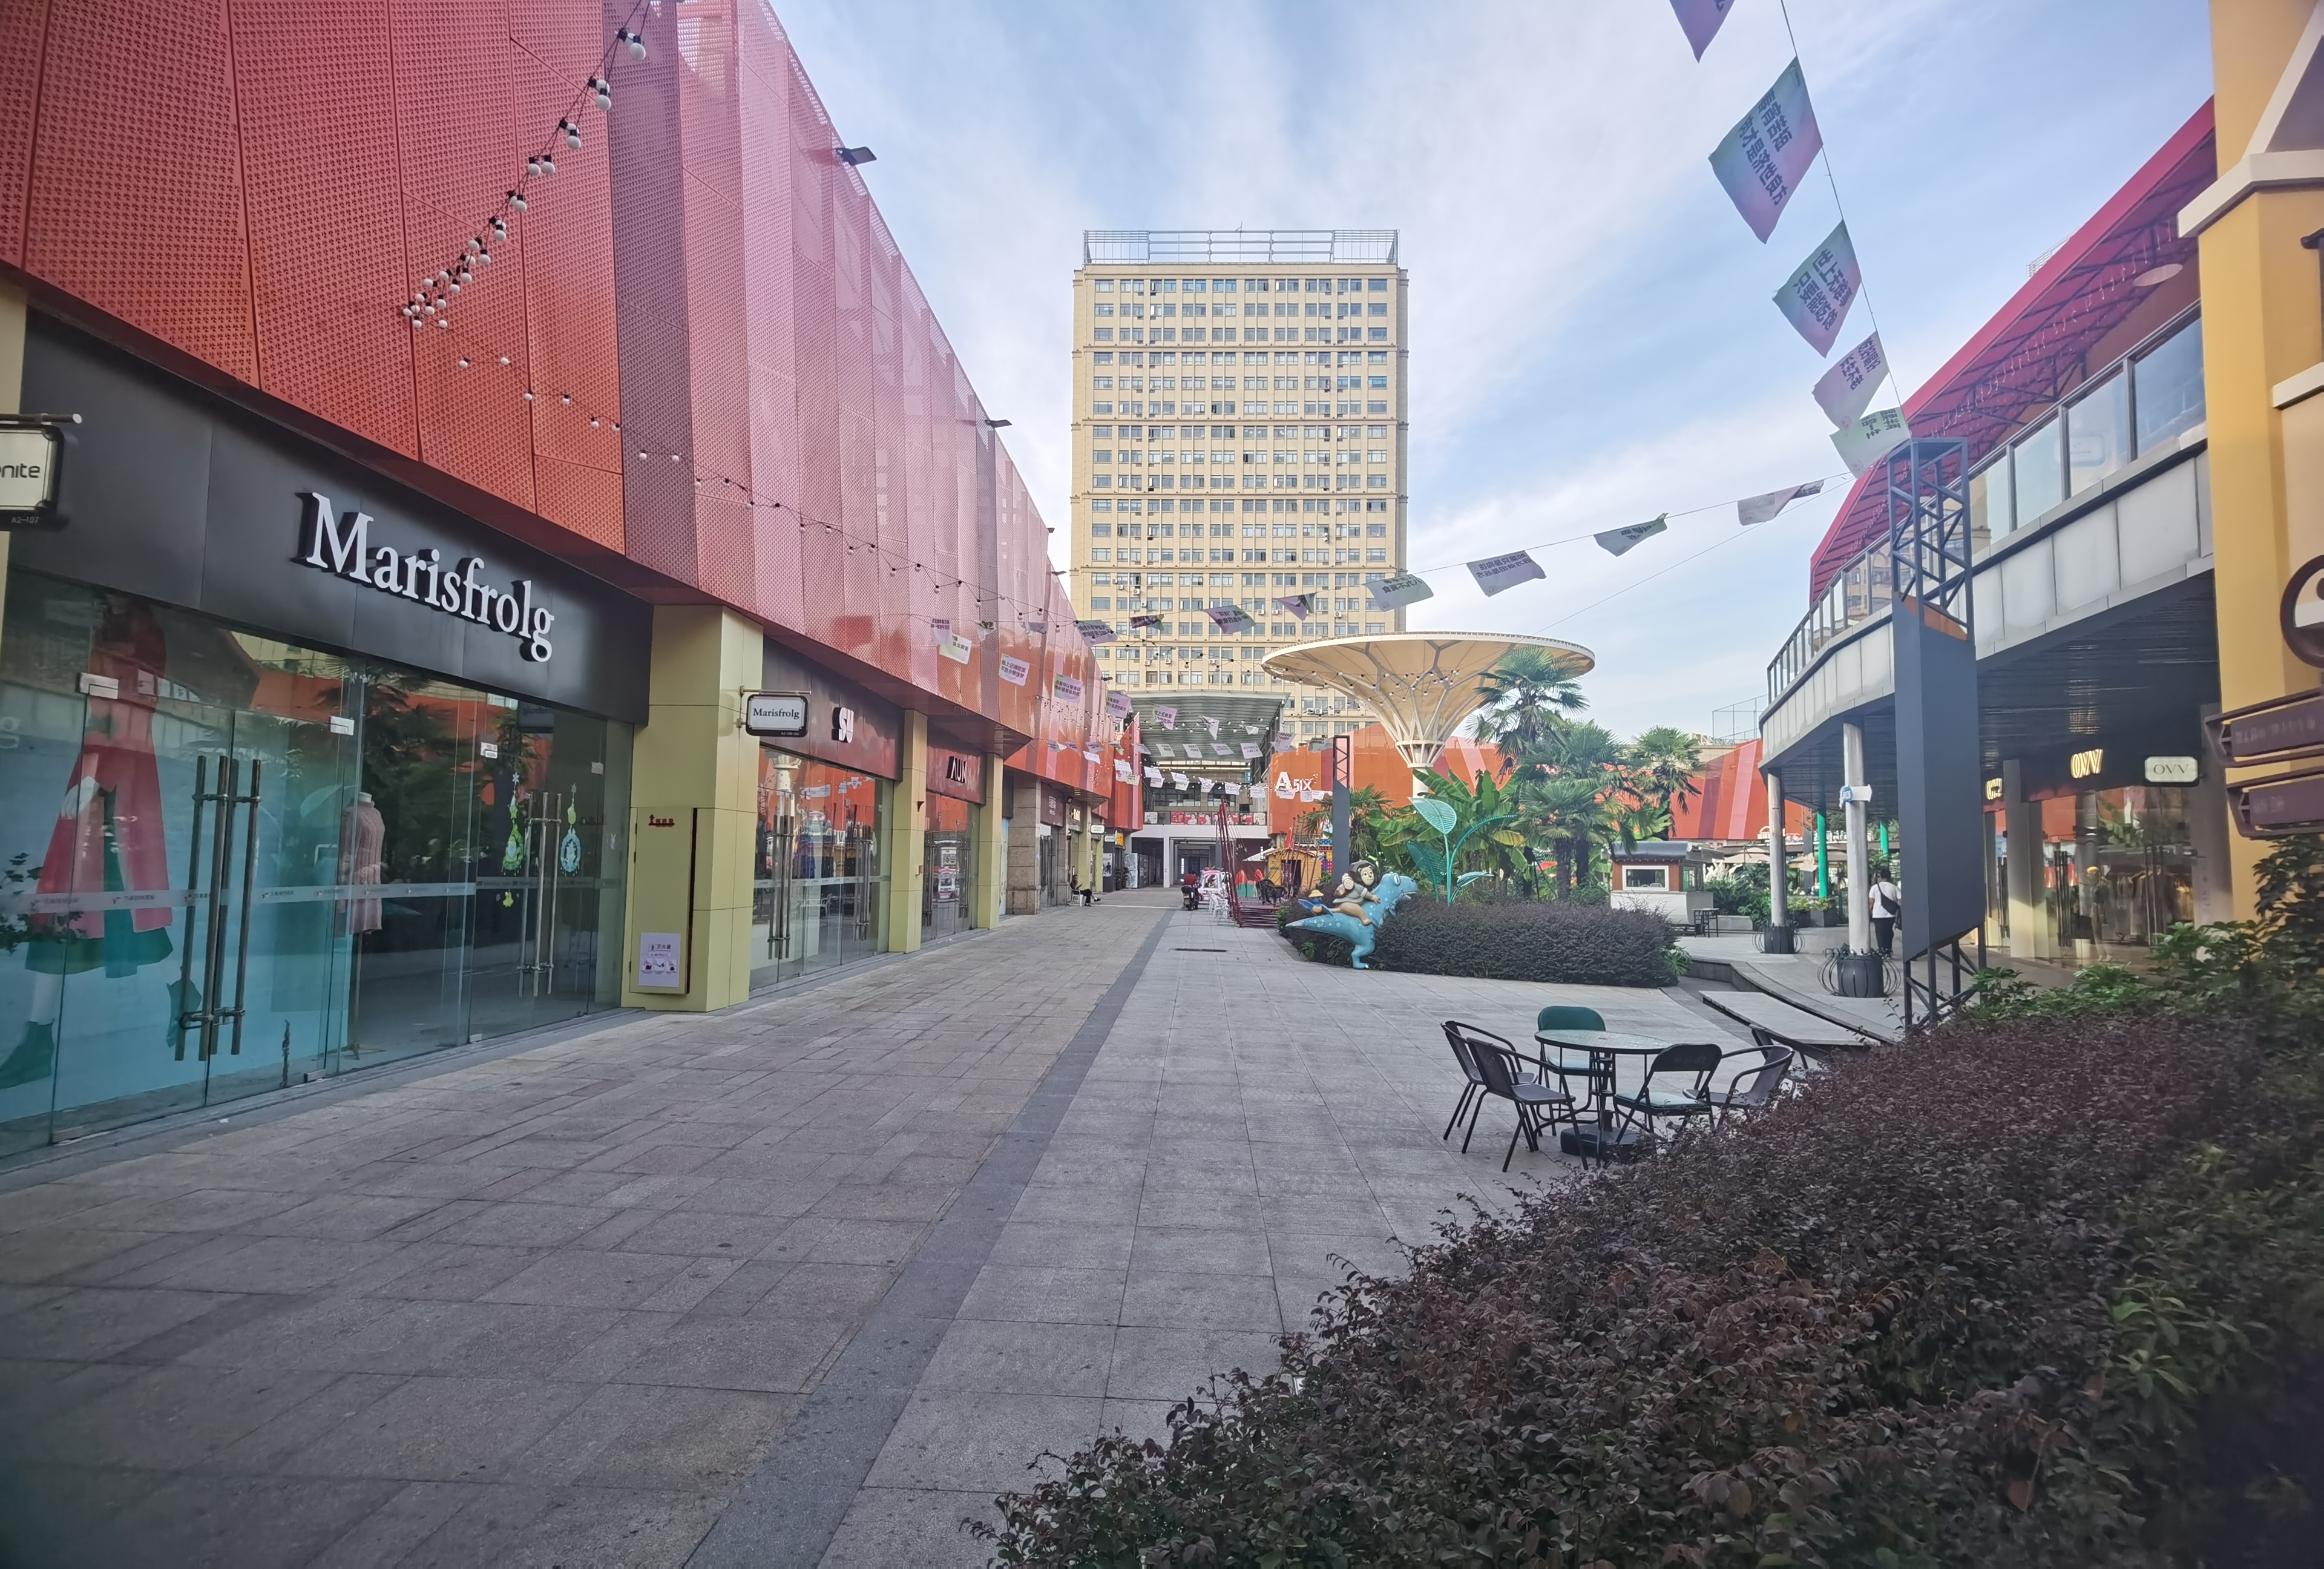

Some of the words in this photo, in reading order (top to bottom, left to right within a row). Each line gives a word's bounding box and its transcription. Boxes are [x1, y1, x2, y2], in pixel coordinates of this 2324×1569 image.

[1837, 354, 1865, 391] 长生不老
[0, 463, 40, 478] nite
[304, 490, 555, 663] Marisfrolg
[753, 708, 800, 720] Marisfrolg
[2153, 763, 2190, 775] OVV
